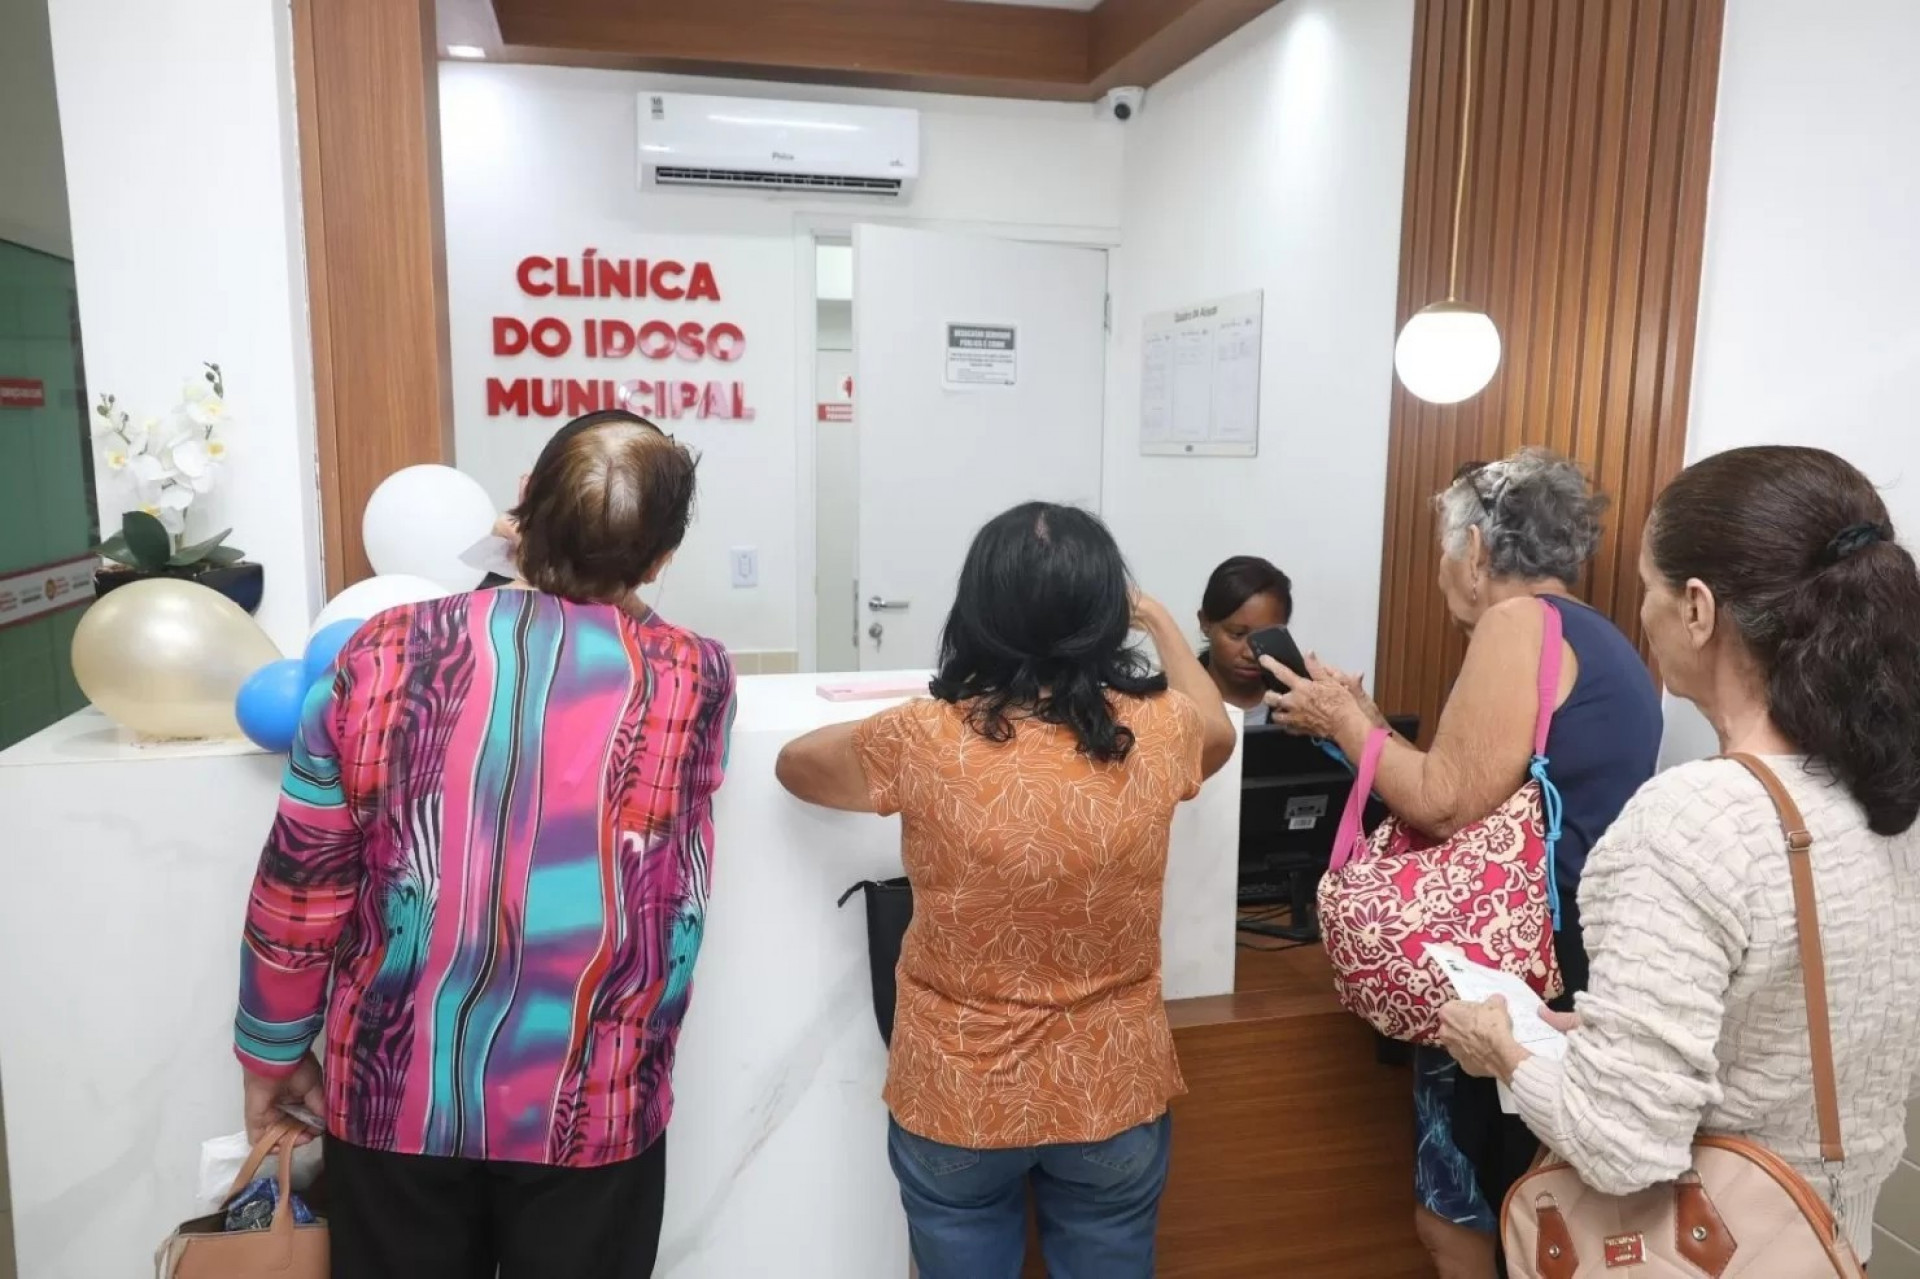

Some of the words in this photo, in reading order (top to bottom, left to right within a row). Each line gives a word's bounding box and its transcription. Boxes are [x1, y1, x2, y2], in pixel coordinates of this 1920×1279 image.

[516, 248, 720, 301] CLÍNICA
[492, 316, 572, 358] DO
[584, 319, 746, 362] IDOSO
[486, 377, 755, 420] MUNICIPAL
